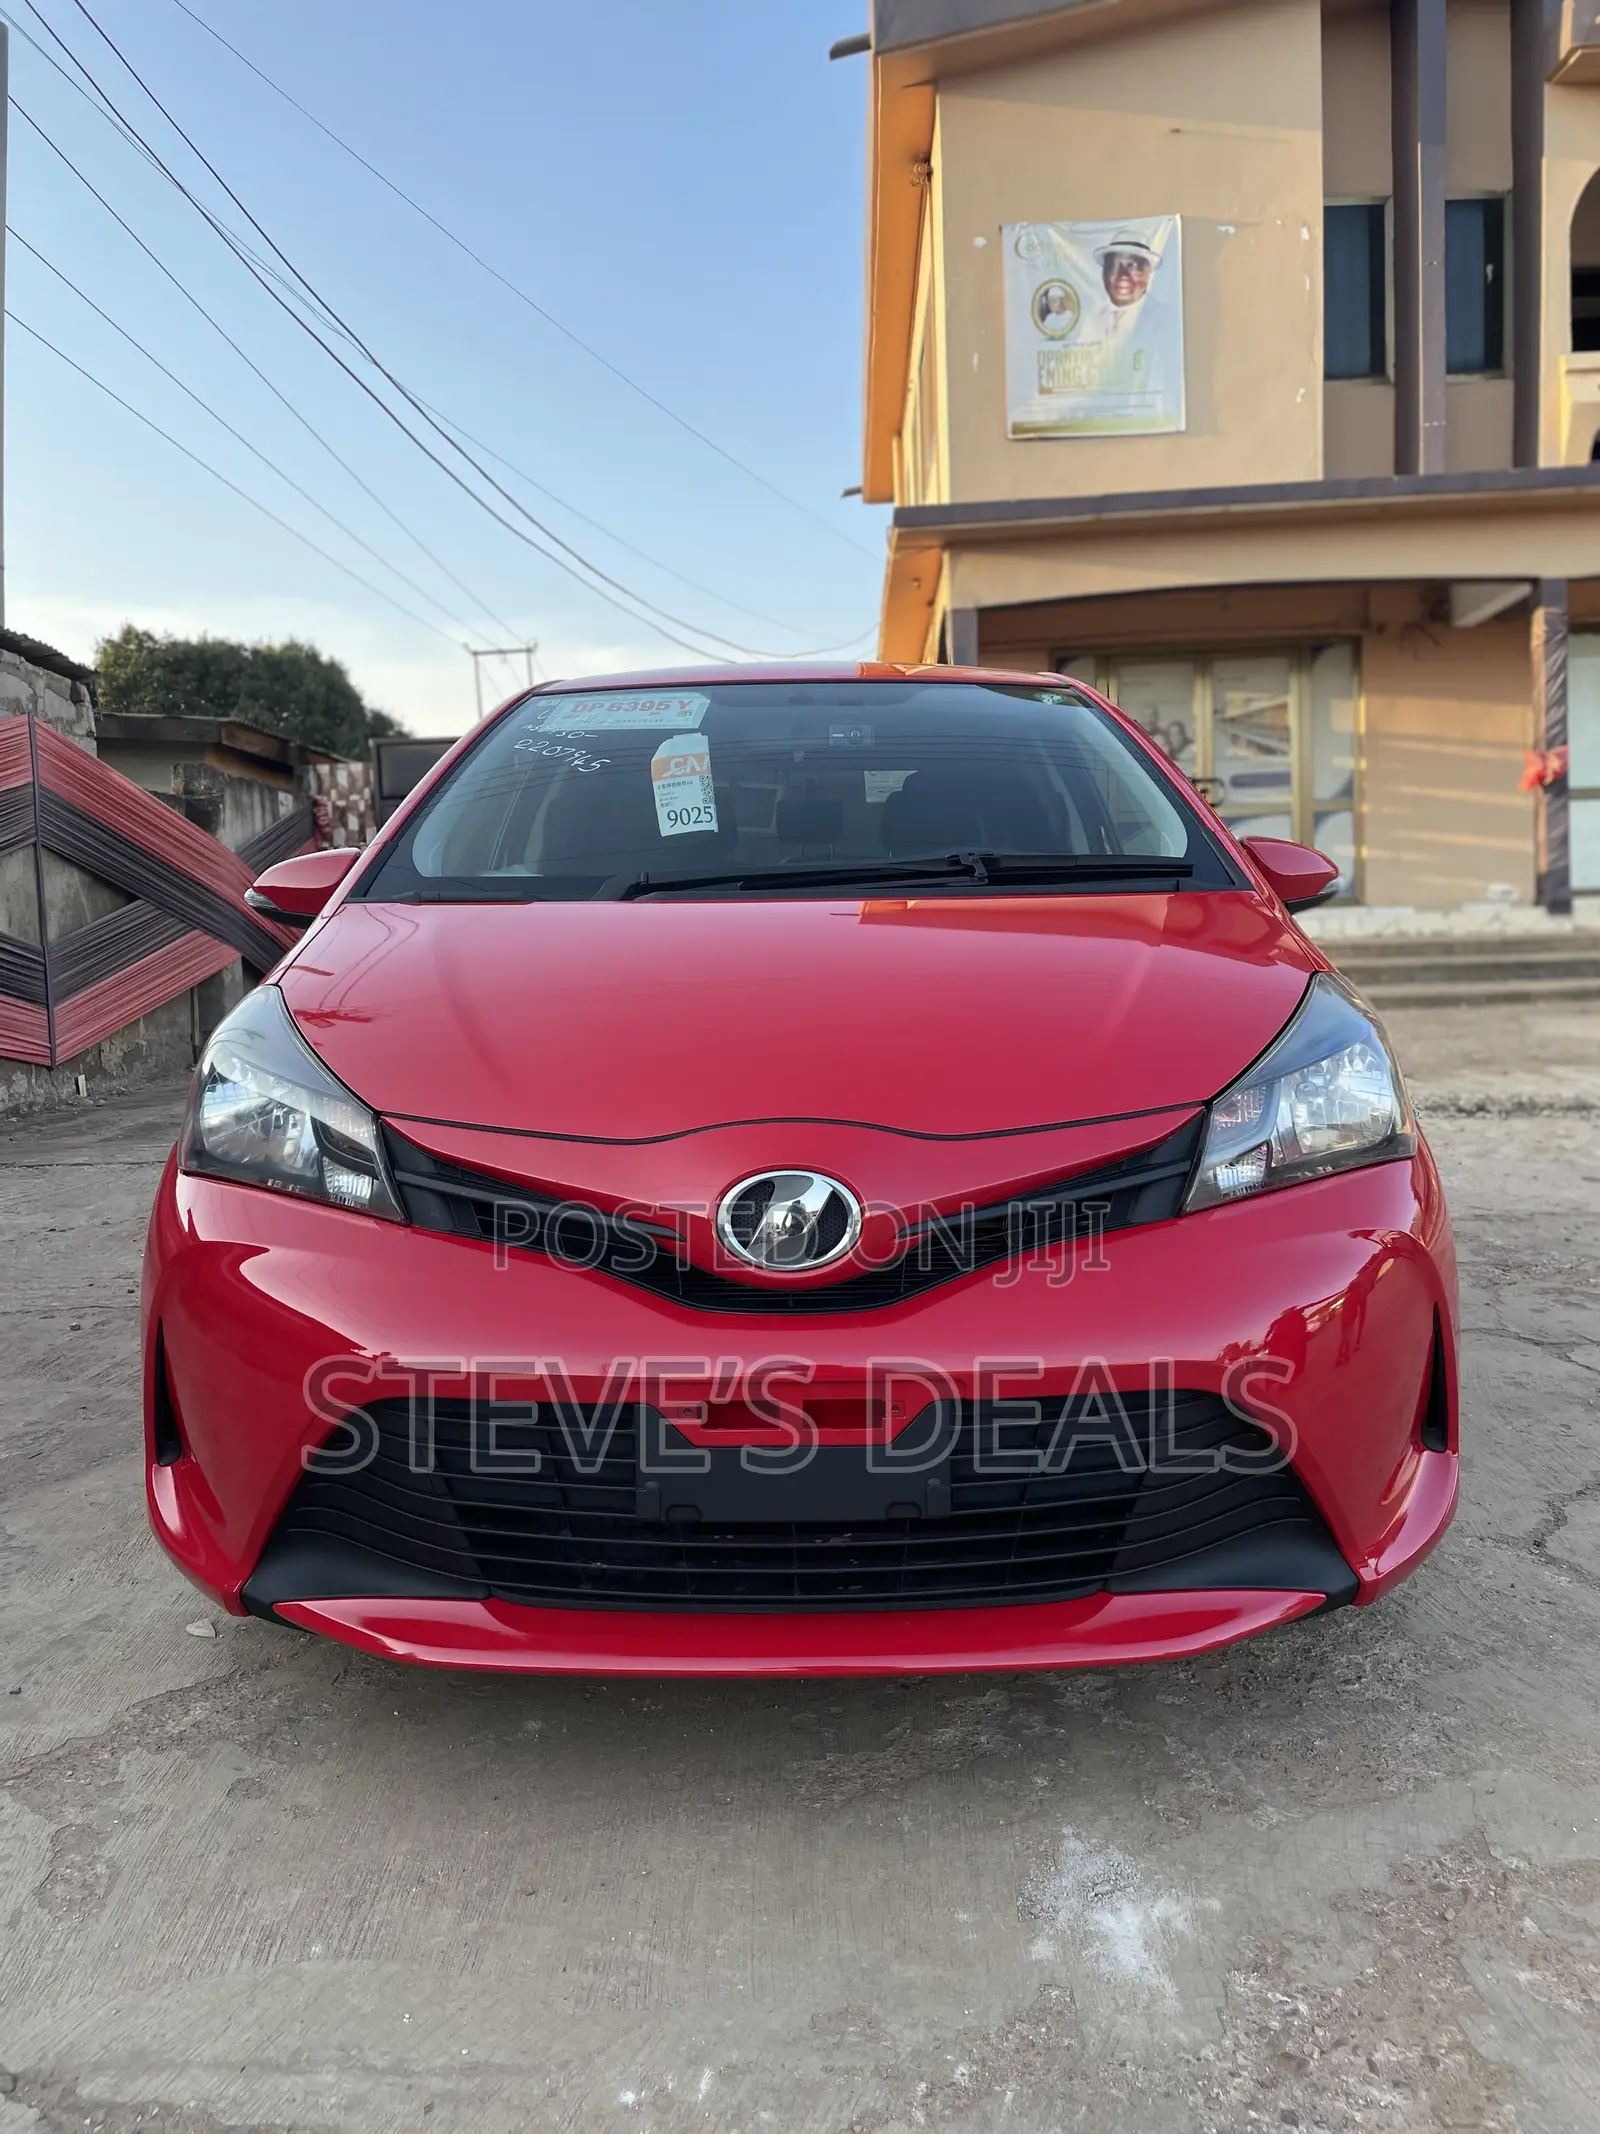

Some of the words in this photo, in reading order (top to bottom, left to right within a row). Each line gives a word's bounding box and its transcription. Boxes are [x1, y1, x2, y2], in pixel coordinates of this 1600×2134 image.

[605, 700, 672, 713] 6395
[677, 699, 694, 710] Y
[666, 805, 714, 828] 9025
